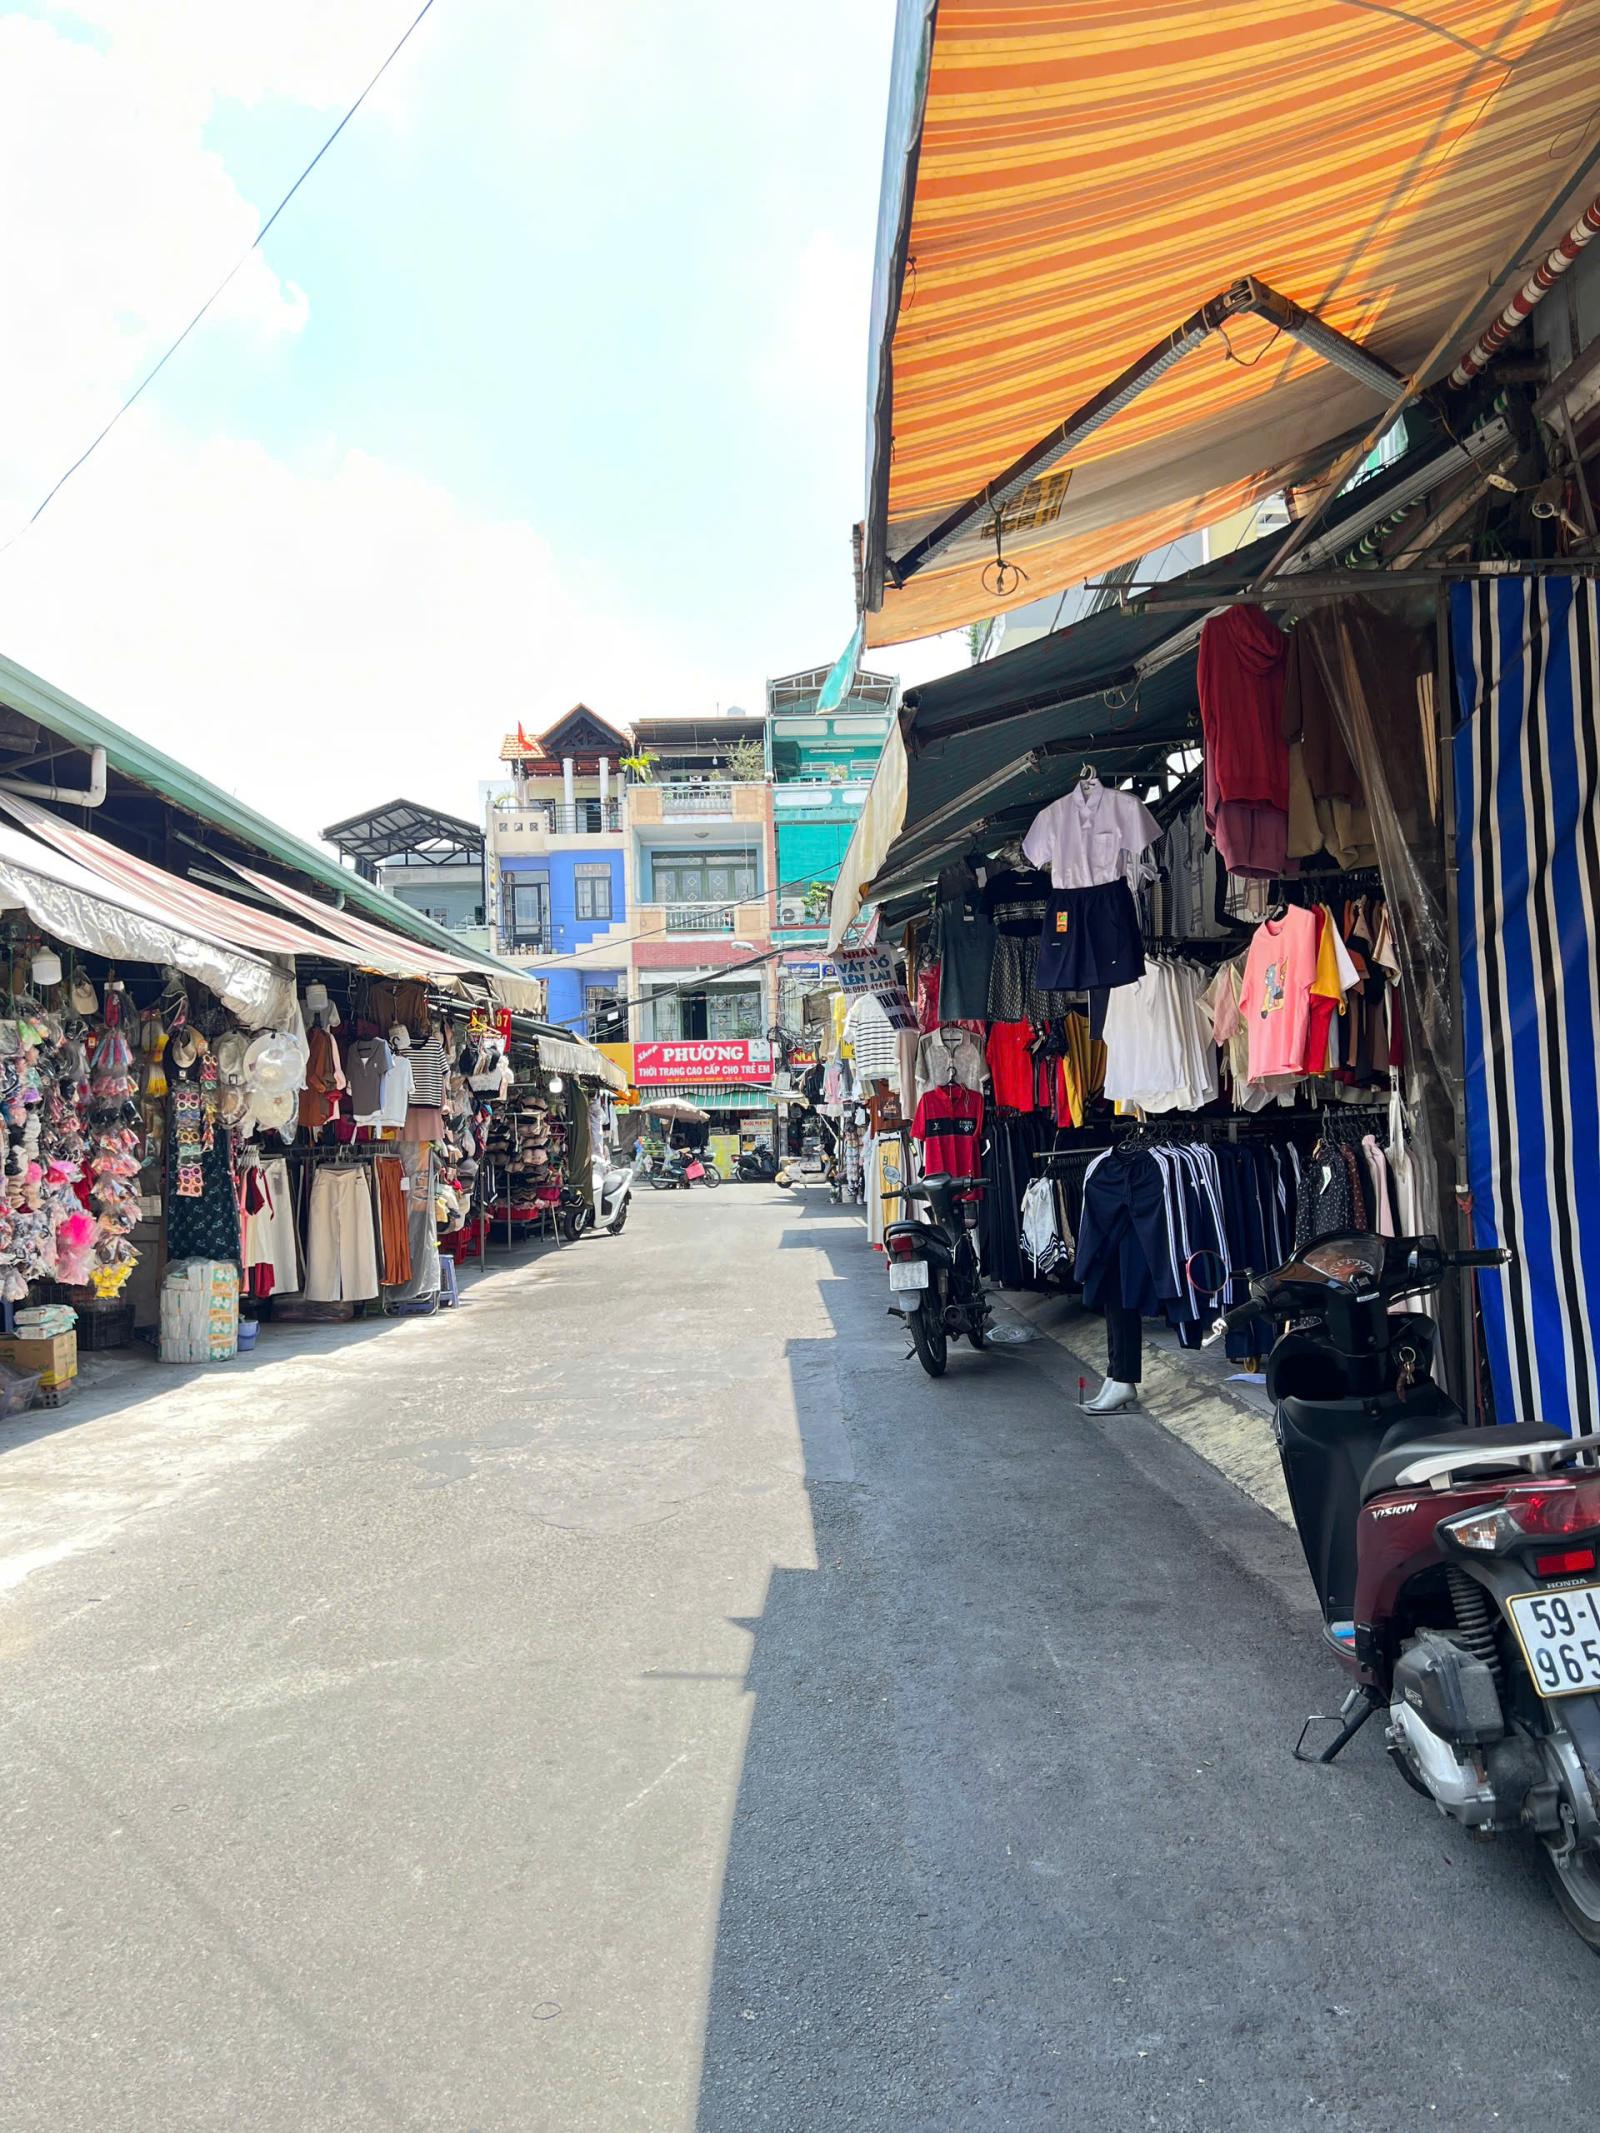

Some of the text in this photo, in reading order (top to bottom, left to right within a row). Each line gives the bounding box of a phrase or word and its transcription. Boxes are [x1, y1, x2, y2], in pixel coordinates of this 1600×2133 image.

[637, 1043, 745, 1063] Shop PHƯƠNG
[659, 1066, 685, 1077] TRANG
[686, 1066, 702, 1076] CAO
[704, 1063, 720, 1075] CẤP
[722, 1065, 739, 1075] CHO
[740, 1062, 756, 1074] TRẺ
[758, 1064, 770, 1074] EM
[1371, 1502, 1419, 1521] VISION
[1546, 1578, 1588, 1589] HONDA
